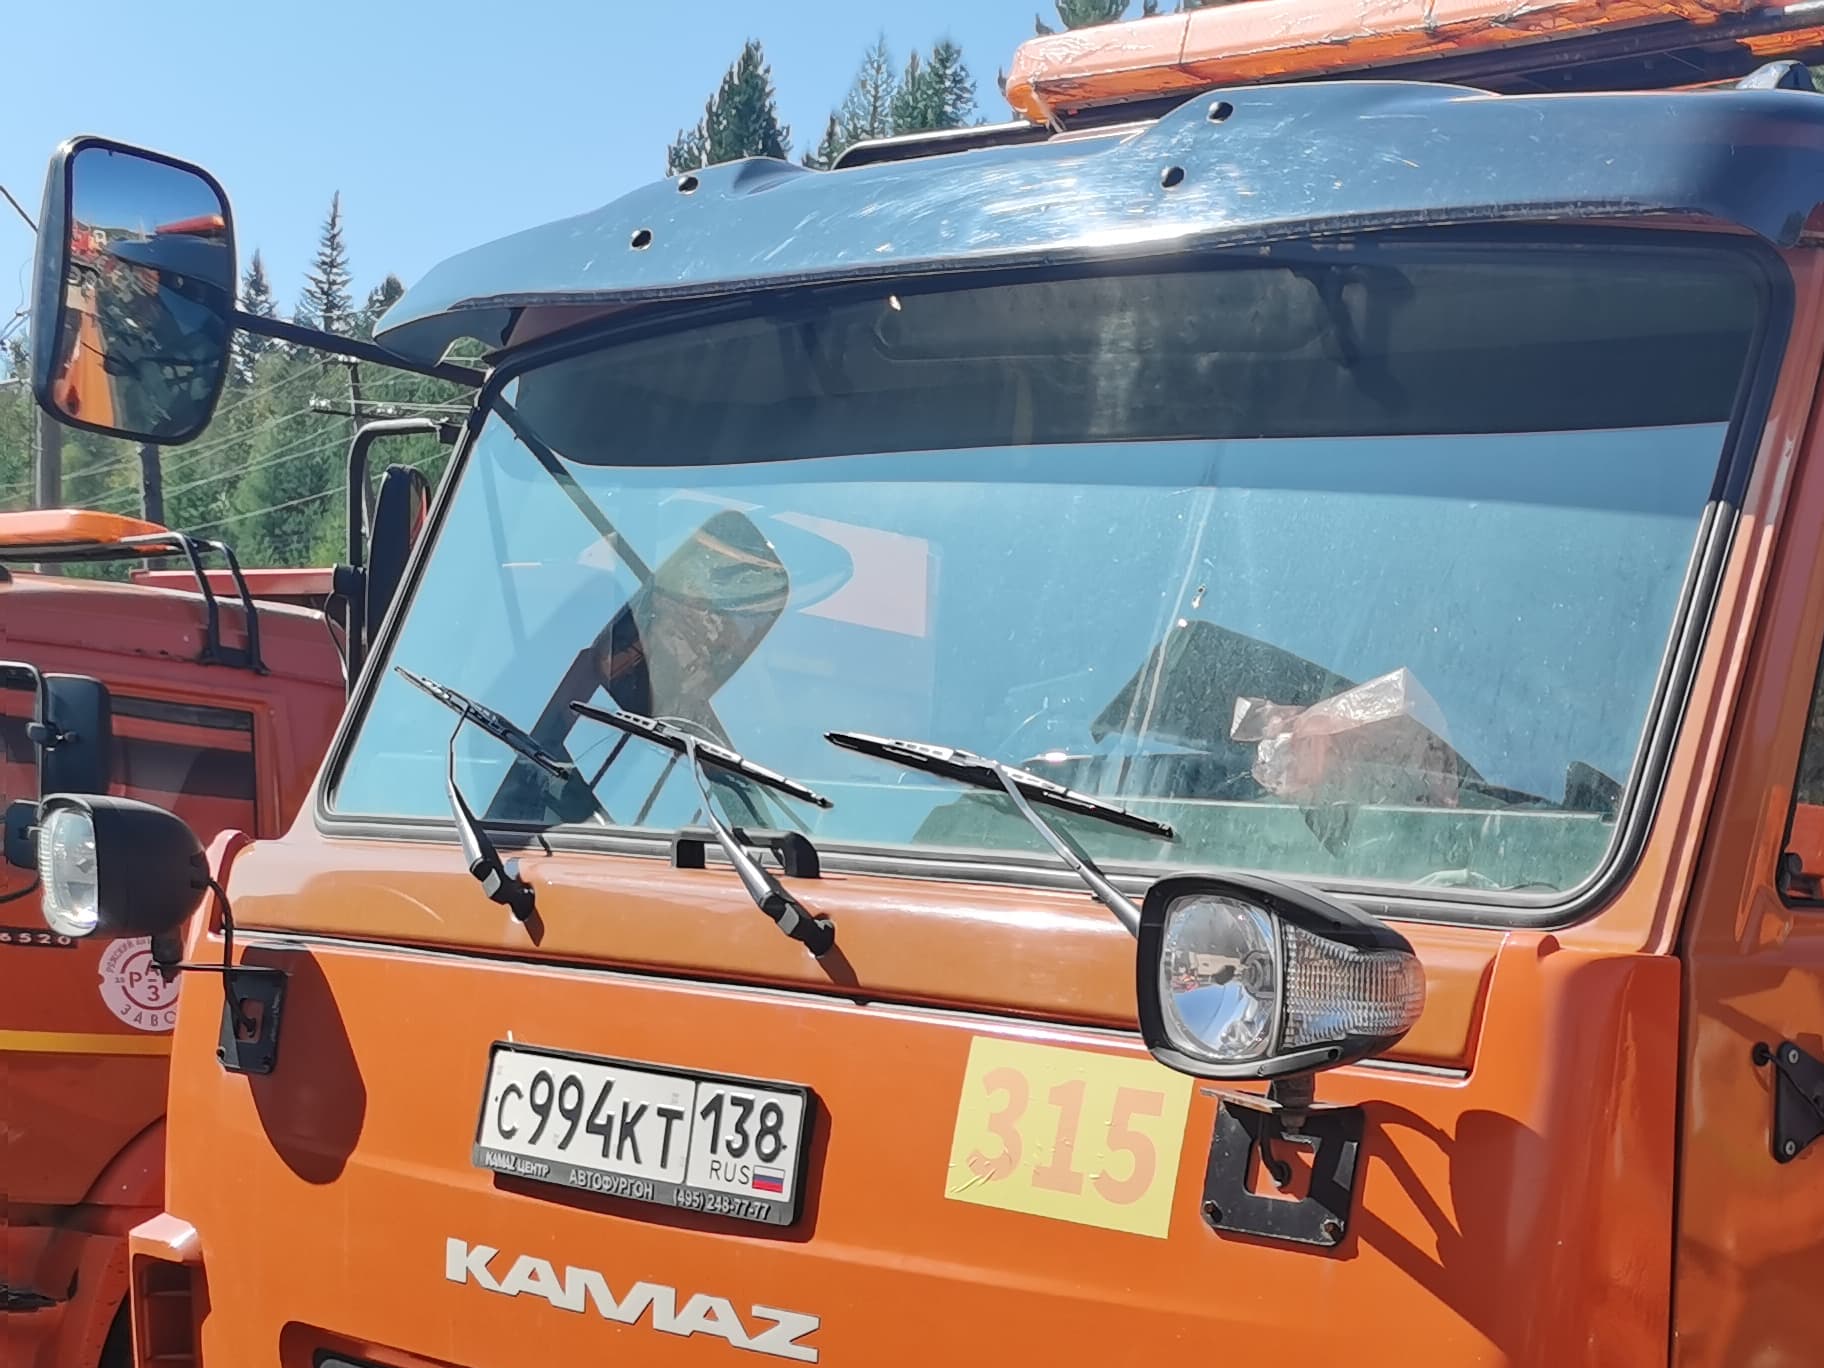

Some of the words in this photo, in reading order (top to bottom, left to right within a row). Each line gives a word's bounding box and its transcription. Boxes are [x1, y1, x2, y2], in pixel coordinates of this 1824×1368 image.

[0, 932, 71, 945] 6520
[121, 1003, 177, 1026] ЗАВО
[497, 1068, 685, 1169] С994КТ
[700, 1092, 784, 1163] 138
[967, 1066, 1166, 1206] 315
[569, 1168, 656, 1200] АВТОФУРГОН
[673, 1188, 704, 1209] (495)
[704, 1194, 771, 1220] 248-77-77
[708, 1159, 751, 1186] RUS
[446, 1237, 820, 1363] KAMAZ
